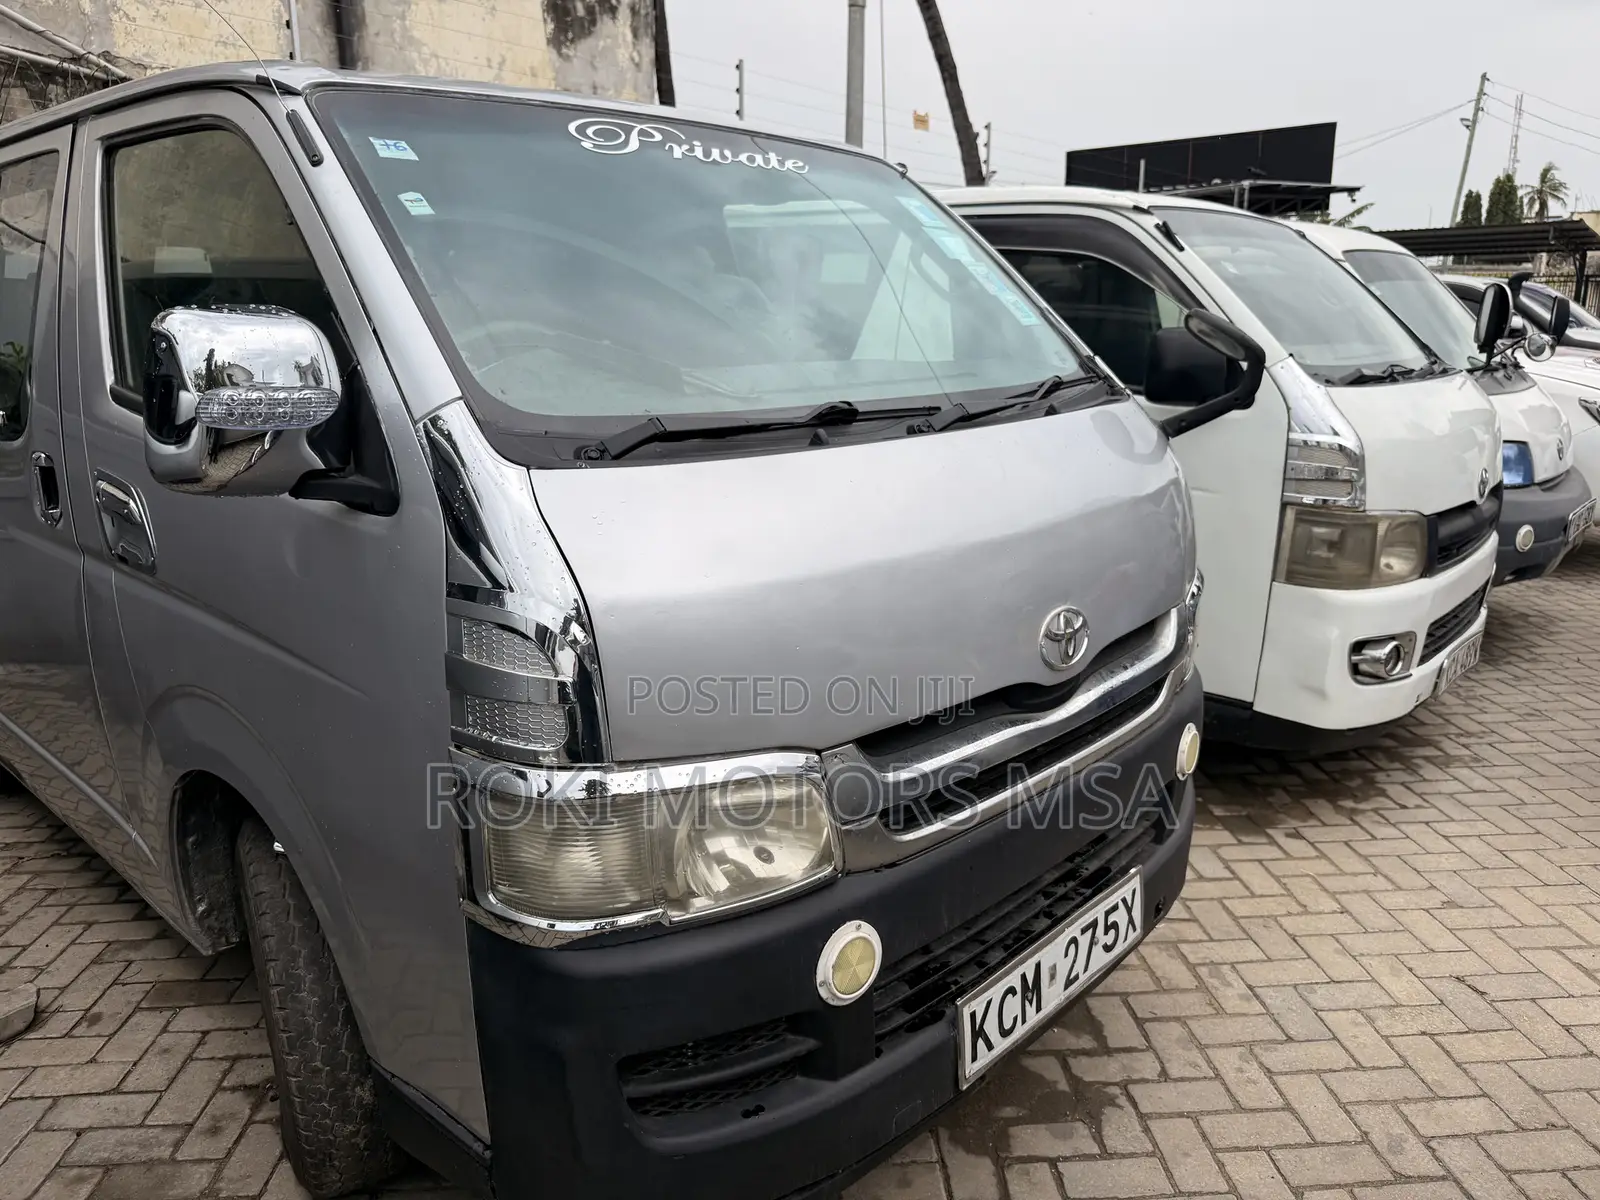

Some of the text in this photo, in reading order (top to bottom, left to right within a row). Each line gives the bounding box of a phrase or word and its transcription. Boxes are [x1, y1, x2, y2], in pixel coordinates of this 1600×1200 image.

[567, 117, 809, 174] Private
[969, 887, 1138, 1064] KCM 275X
